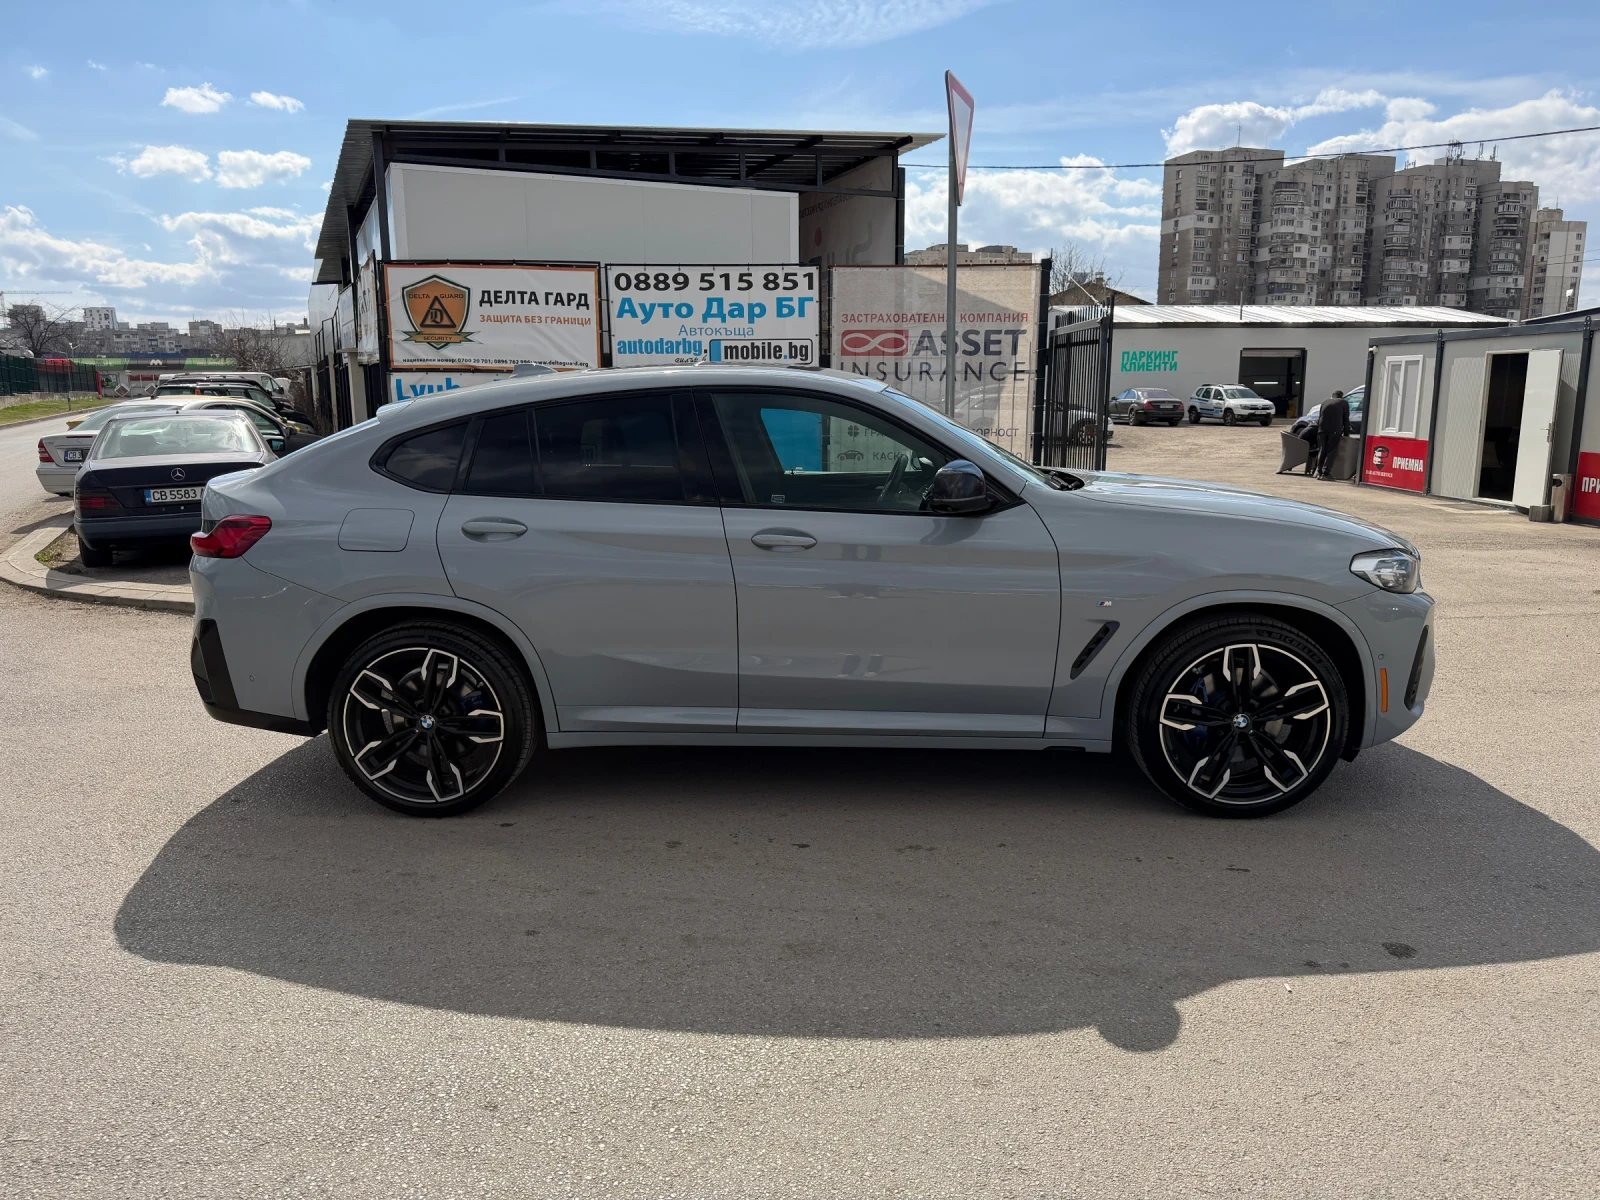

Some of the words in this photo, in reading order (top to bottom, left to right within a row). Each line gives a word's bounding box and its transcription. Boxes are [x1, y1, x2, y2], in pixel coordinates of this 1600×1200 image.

[614, 272, 690, 291] 0889
[699, 272, 753, 291] 515
[762, 272, 814, 291] 851
[479, 290, 540, 307] ДЕЛТА
[545, 292, 589, 310] ГАРД
[616, 297, 694, 324] Ауто
[702, 297, 766, 324] Дар
[776, 297, 814, 318] БГ
[480, 315, 522, 324] ЗАЩИТА
[524, 316, 542, 324] БЕЗ
[545, 316, 591, 327] ГРАНИЦИ
[841, 313, 947, 323] ЗАСТРАХОВАТЕЛН
[960, 313, 1028, 323] КОМПАНИЯ
[678, 325, 754, 338] Автокъща
[724, 342, 809, 362] mobile.bg
[1122, 350, 1178, 361] ПАРКИНГ
[1121, 362, 1177, 372] КЛИЕНТИ
[1392, 456, 1423, 472] ПРИЕМНА
[152, 490, 167, 501] CB
[170, 489, 197, 500] 5583
